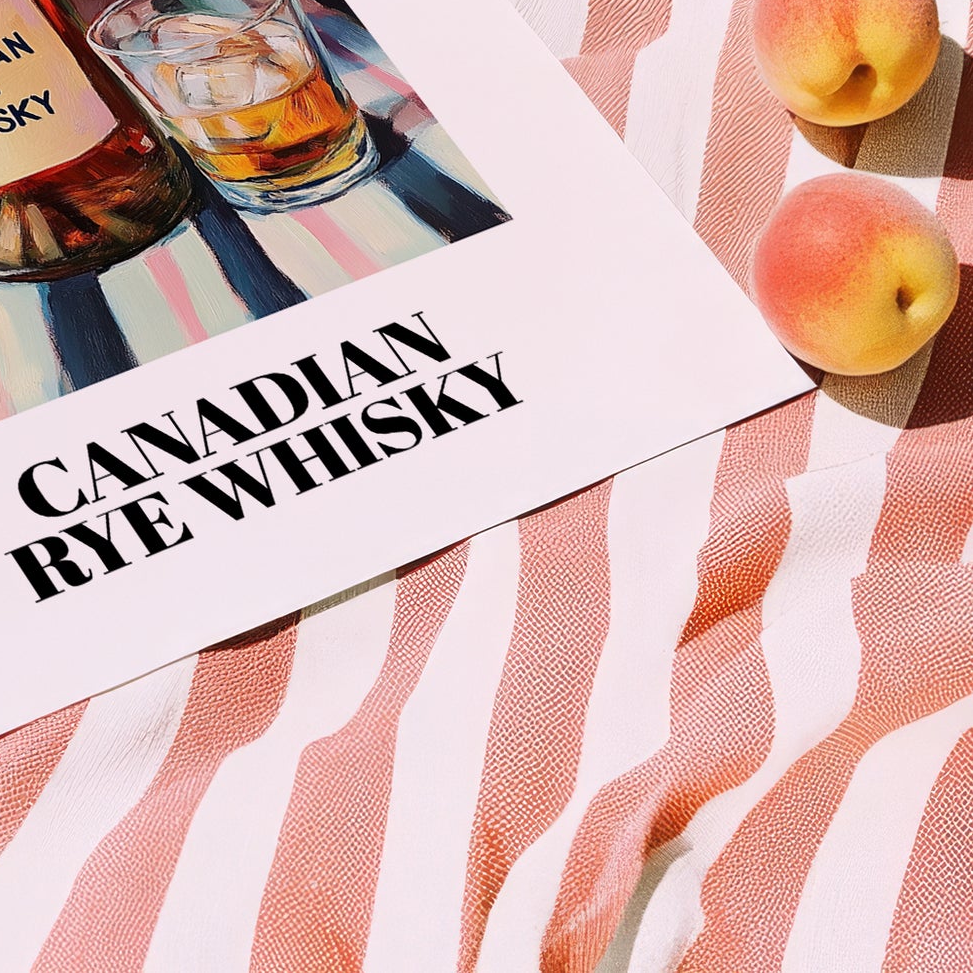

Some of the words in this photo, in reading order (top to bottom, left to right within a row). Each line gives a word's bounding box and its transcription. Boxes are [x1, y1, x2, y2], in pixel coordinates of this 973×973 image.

[4, 491, 194, 603] RYE
[178, 351, 524, 521] WHISKY
[17, 311, 452, 517] CANADIAN
